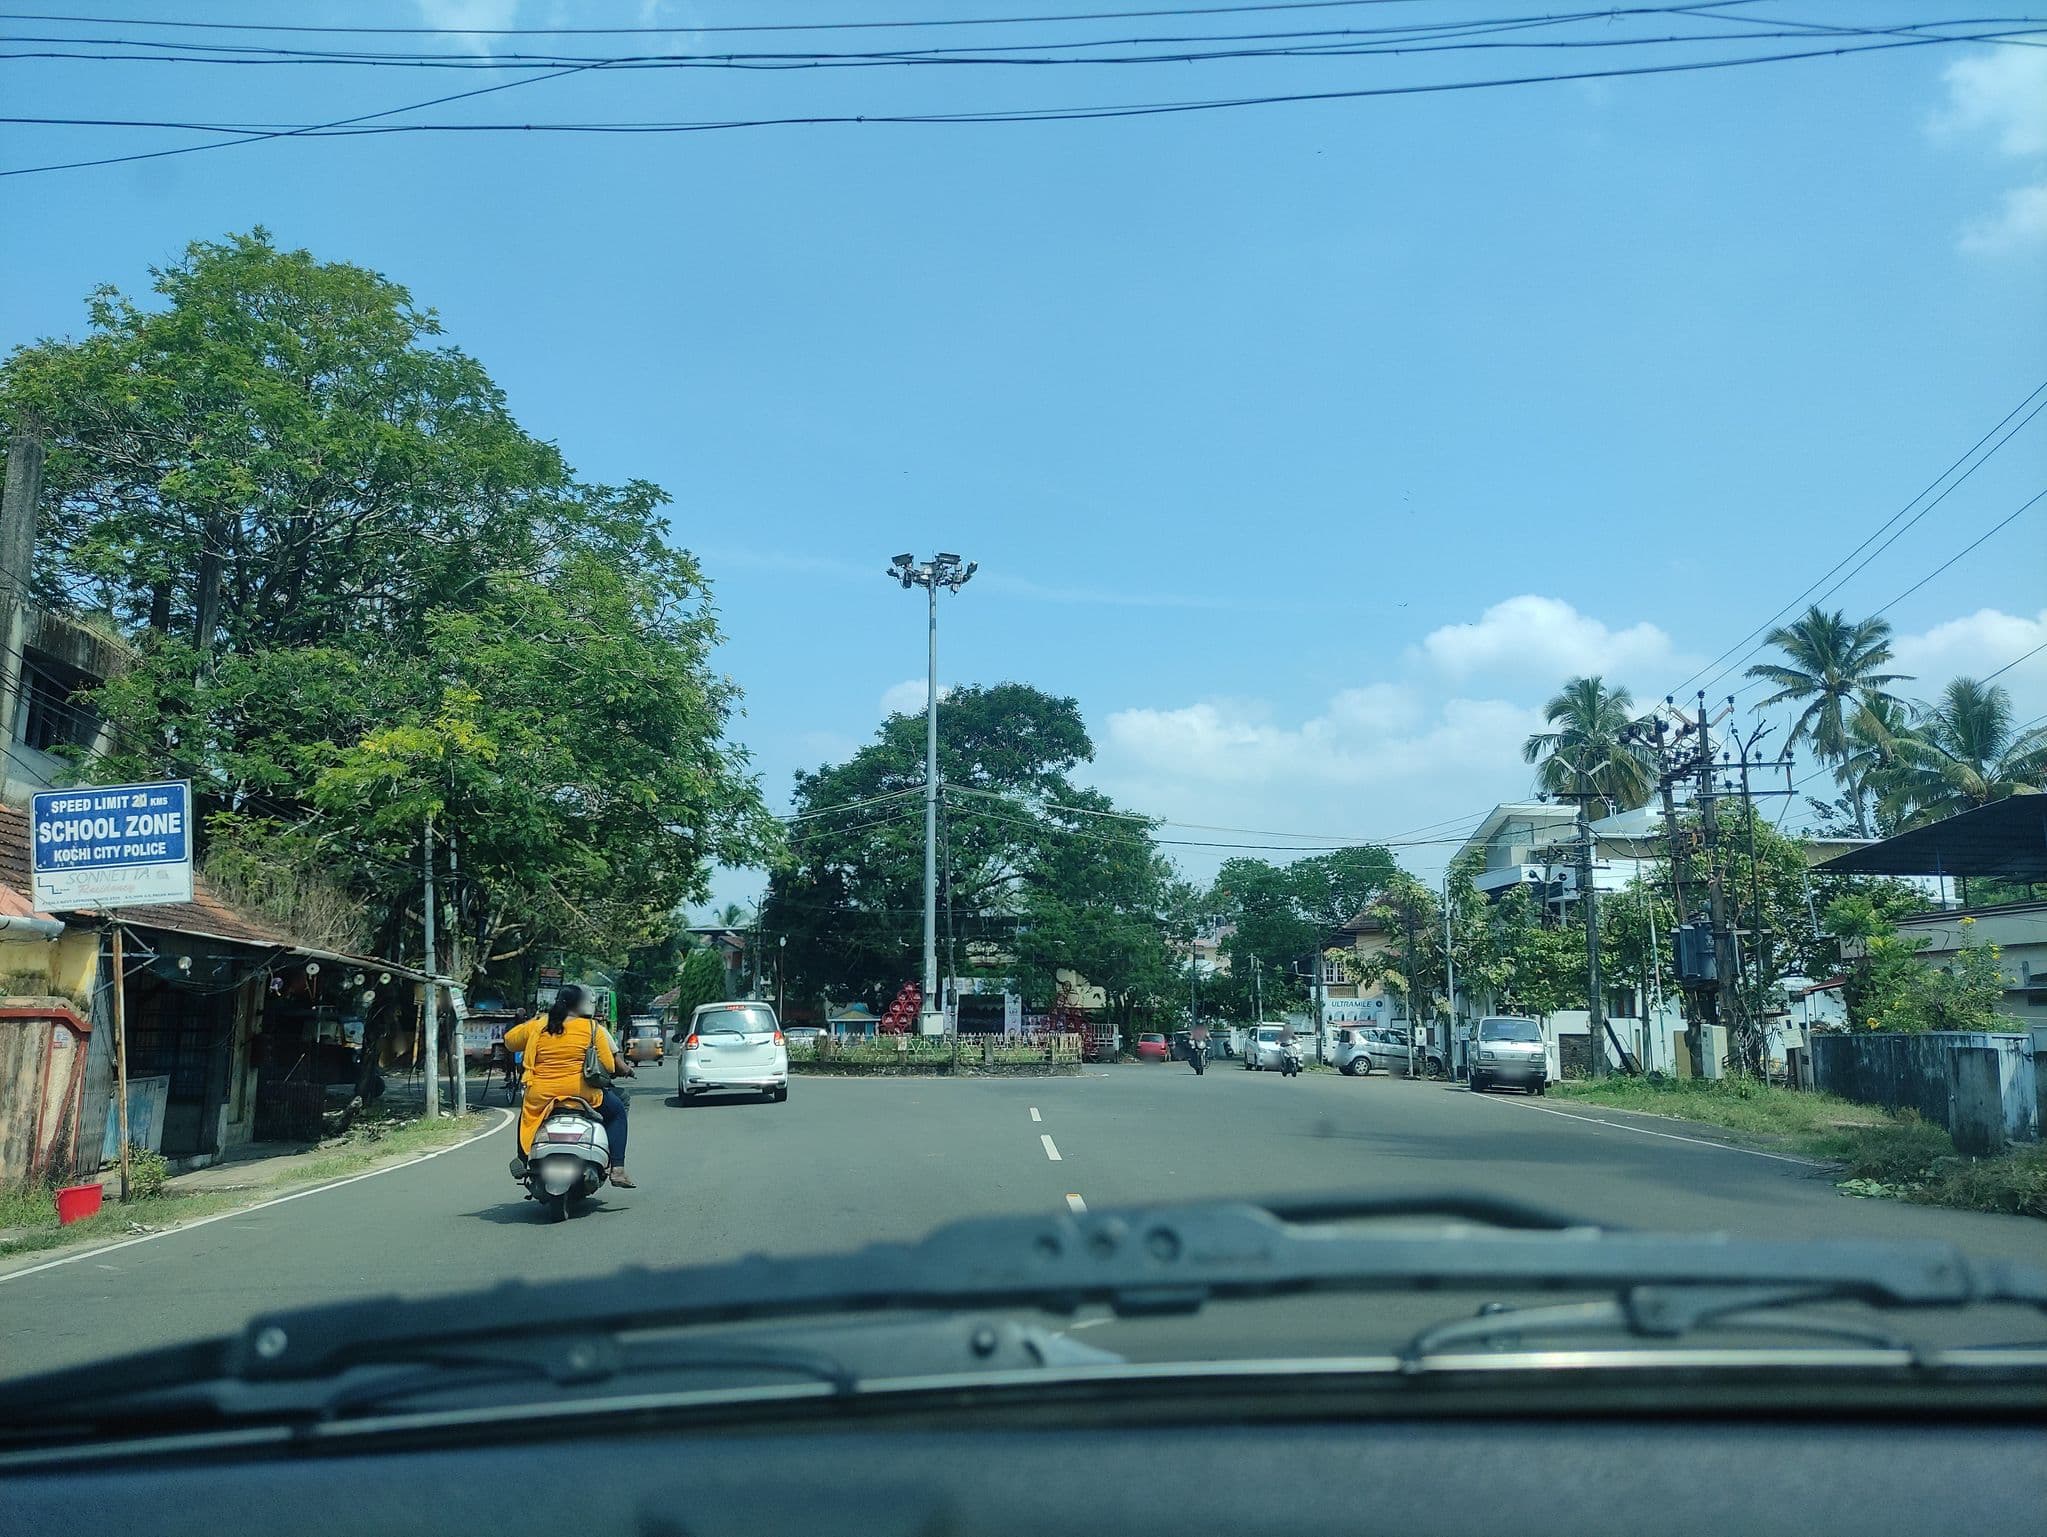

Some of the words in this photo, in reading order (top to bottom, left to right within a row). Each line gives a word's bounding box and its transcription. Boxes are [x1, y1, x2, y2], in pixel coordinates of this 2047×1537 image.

[51, 798, 91, 814] SPEED
[94, 796, 129, 811] LIMIT
[150, 796, 168, 807] KMS
[39, 817, 121, 843] SCHOOL
[126, 812, 182, 837] ZONE
[54, 846, 91, 862] KOCHI
[94, 845, 122, 860] CITY
[124, 842, 167, 858] POLICE
[1331, 1000, 1373, 1008] ULTRAMILE
